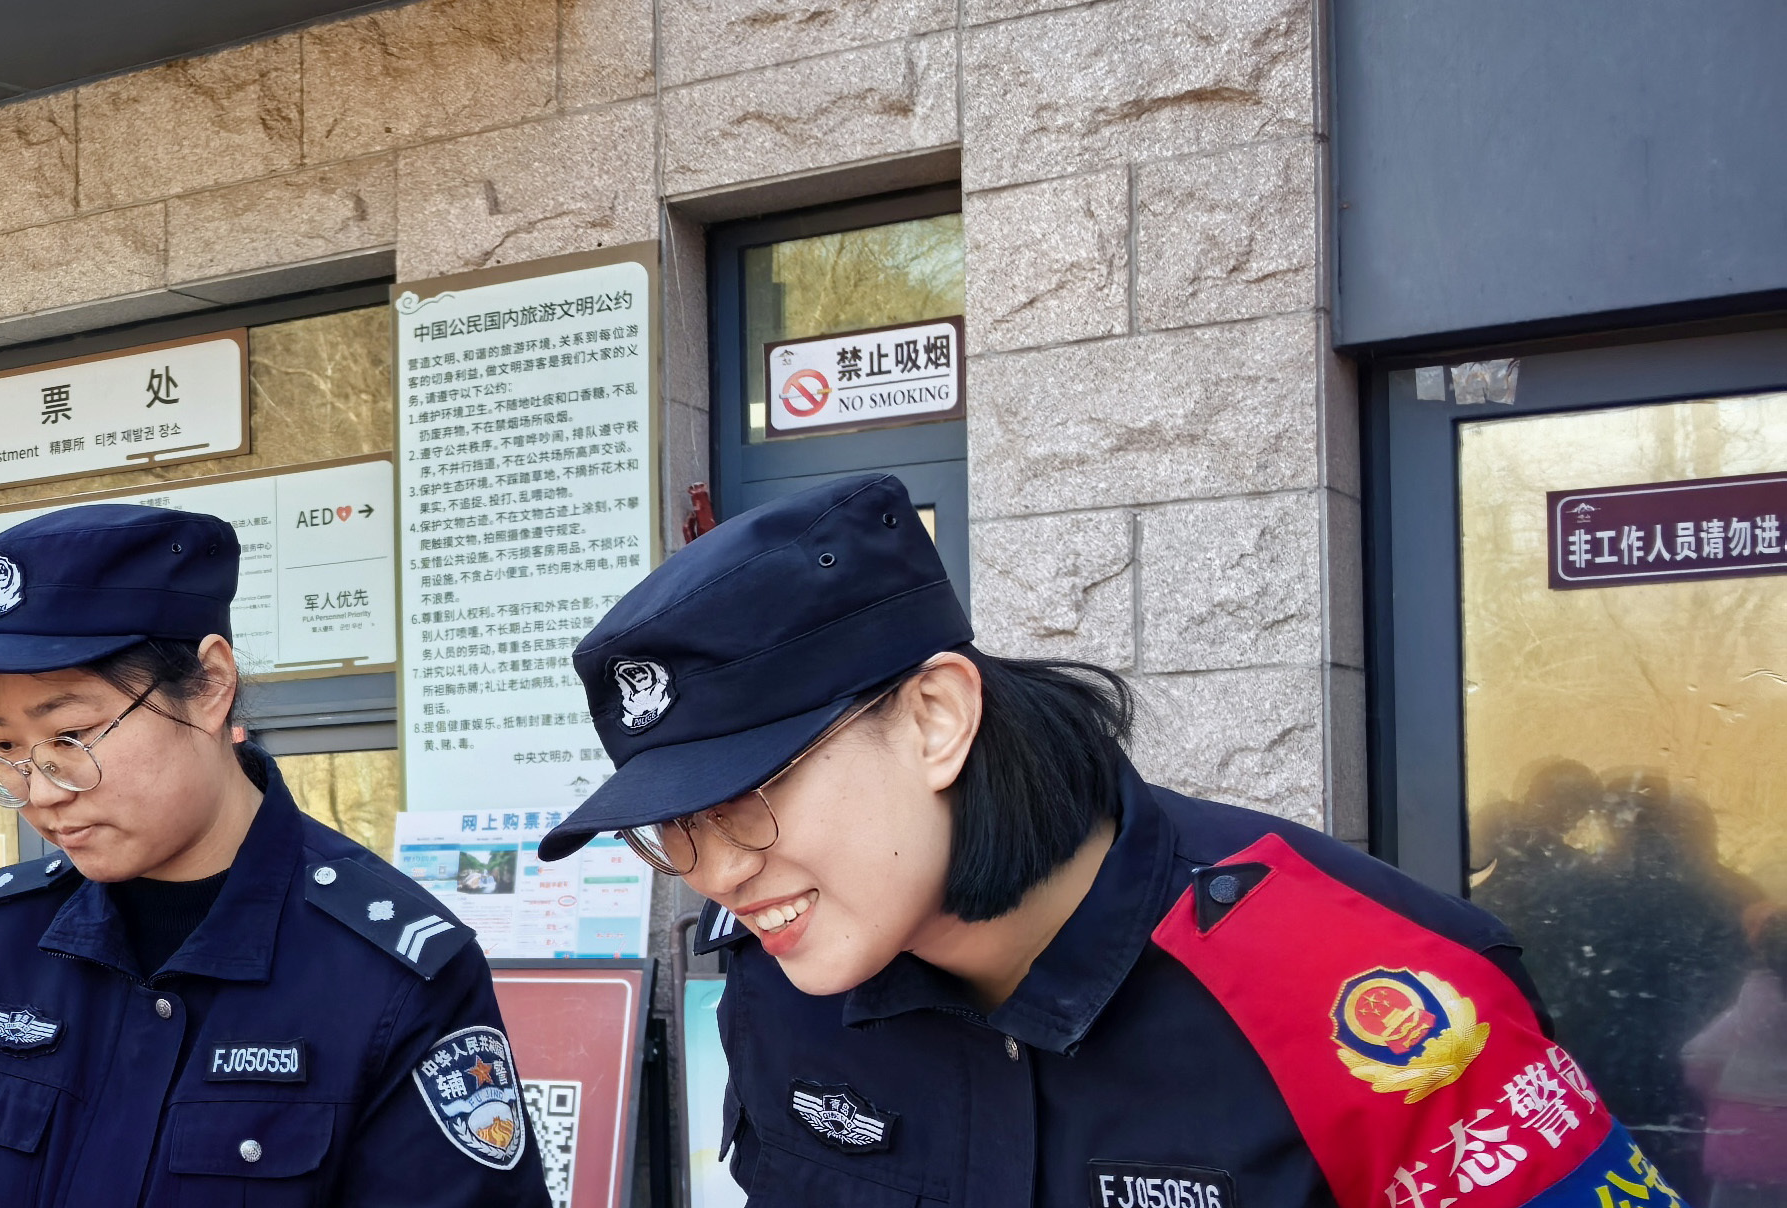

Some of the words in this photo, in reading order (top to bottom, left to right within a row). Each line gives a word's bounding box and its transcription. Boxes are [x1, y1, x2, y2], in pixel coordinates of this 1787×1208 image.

[414, 290, 633, 342] 中国公民国内旅游文明公约
[836, 334, 951, 382] 禁止吸烟
[838, 395, 864, 414] NO
[869, 384, 950, 409] SMOKING
[49, 436, 86, 456] 精算所
[95, 429, 117, 448] 티켓
[120, 425, 155, 445] 재발권
[158, 422, 182, 439] 장소
[296, 507, 334, 528] AED
[1568, 514, 1787, 568] 非工作人员请勿进
[304, 588, 369, 611] 军人优先
[513, 750, 574, 765] 中央文明办
[580, 748, 609, 761] 国家
[462, 810, 573, 832] 网上购票流
[212, 1047, 299, 1073] FJ050550
[435, 1069, 468, 1100] 辅
